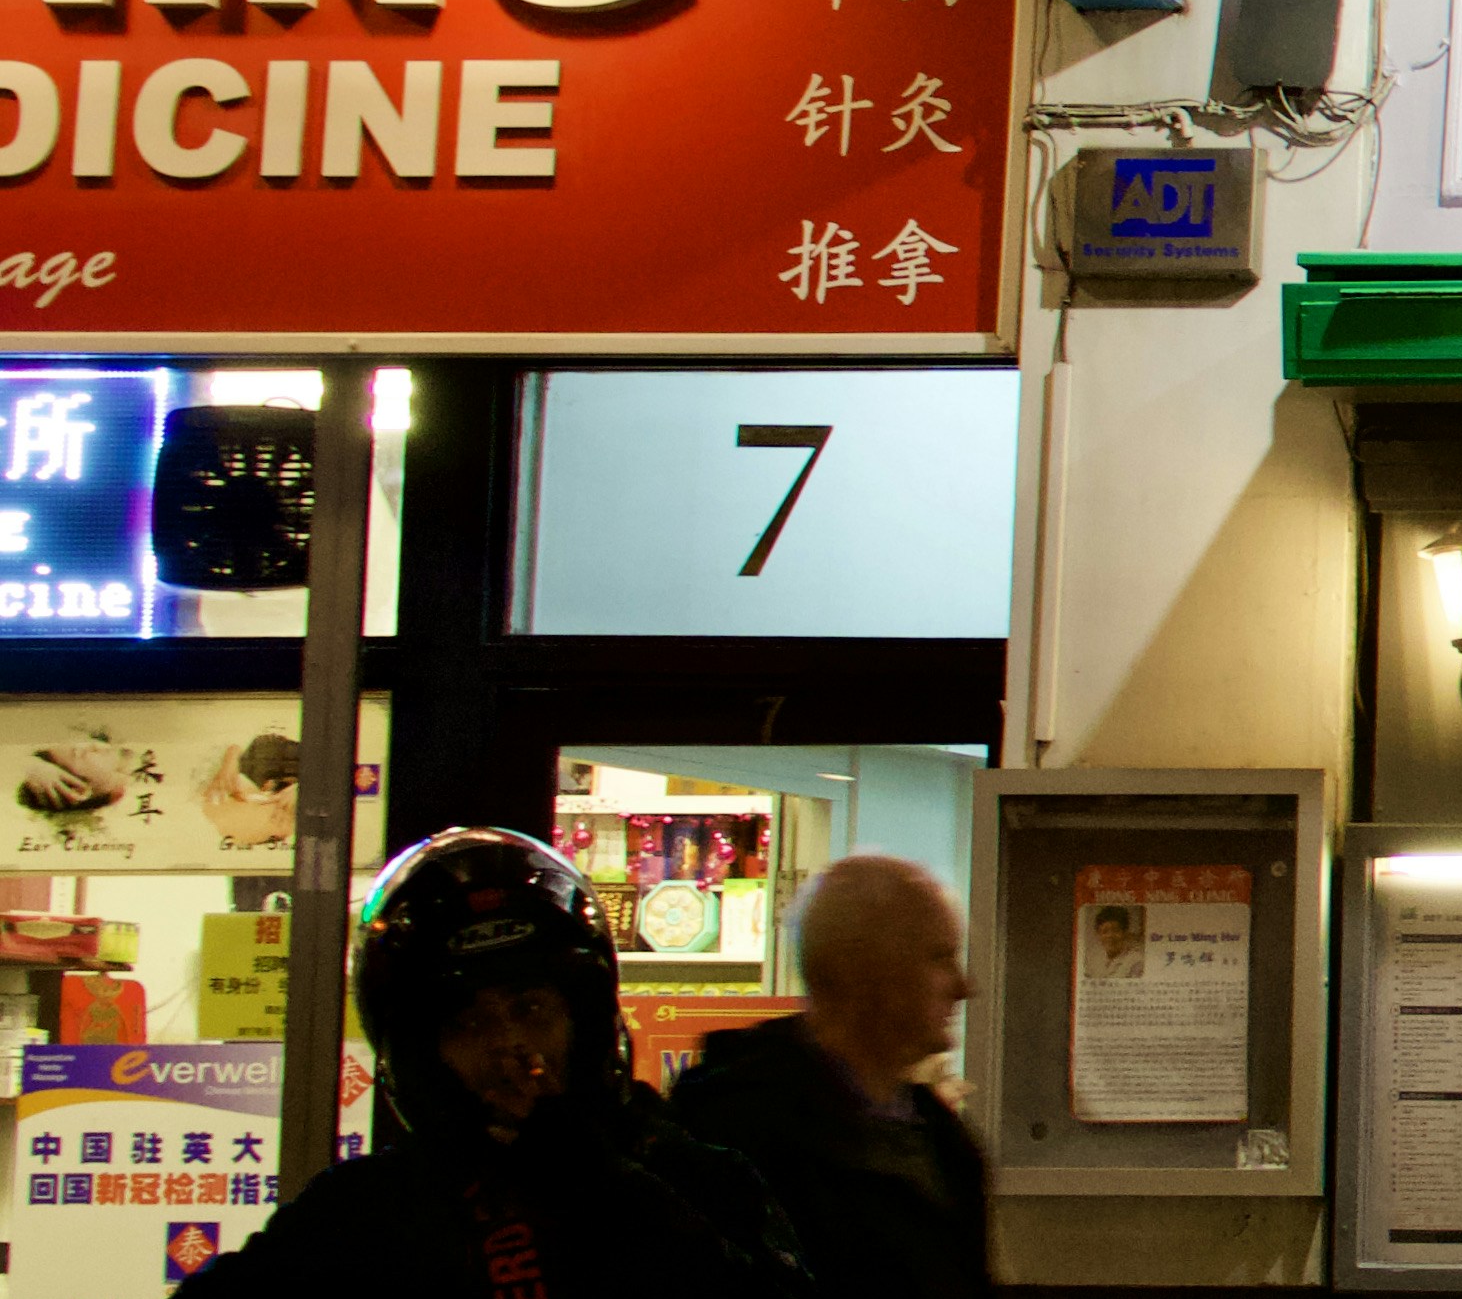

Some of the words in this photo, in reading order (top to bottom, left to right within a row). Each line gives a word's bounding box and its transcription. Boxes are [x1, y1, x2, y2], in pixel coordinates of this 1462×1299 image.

[784, 72, 963, 157] 针灸
[1111, 171, 1216, 226] ADT
[777, 217, 959, 303] 推拿
[1083, 243, 1156, 258] Security
[1163, 242, 1240, 259] Systems
[734, 424, 834, 577] 7
[18, 836, 53, 853] Ear
[62, 835, 136, 860] Cleaning
[177, 1225, 215, 1265] 泰
